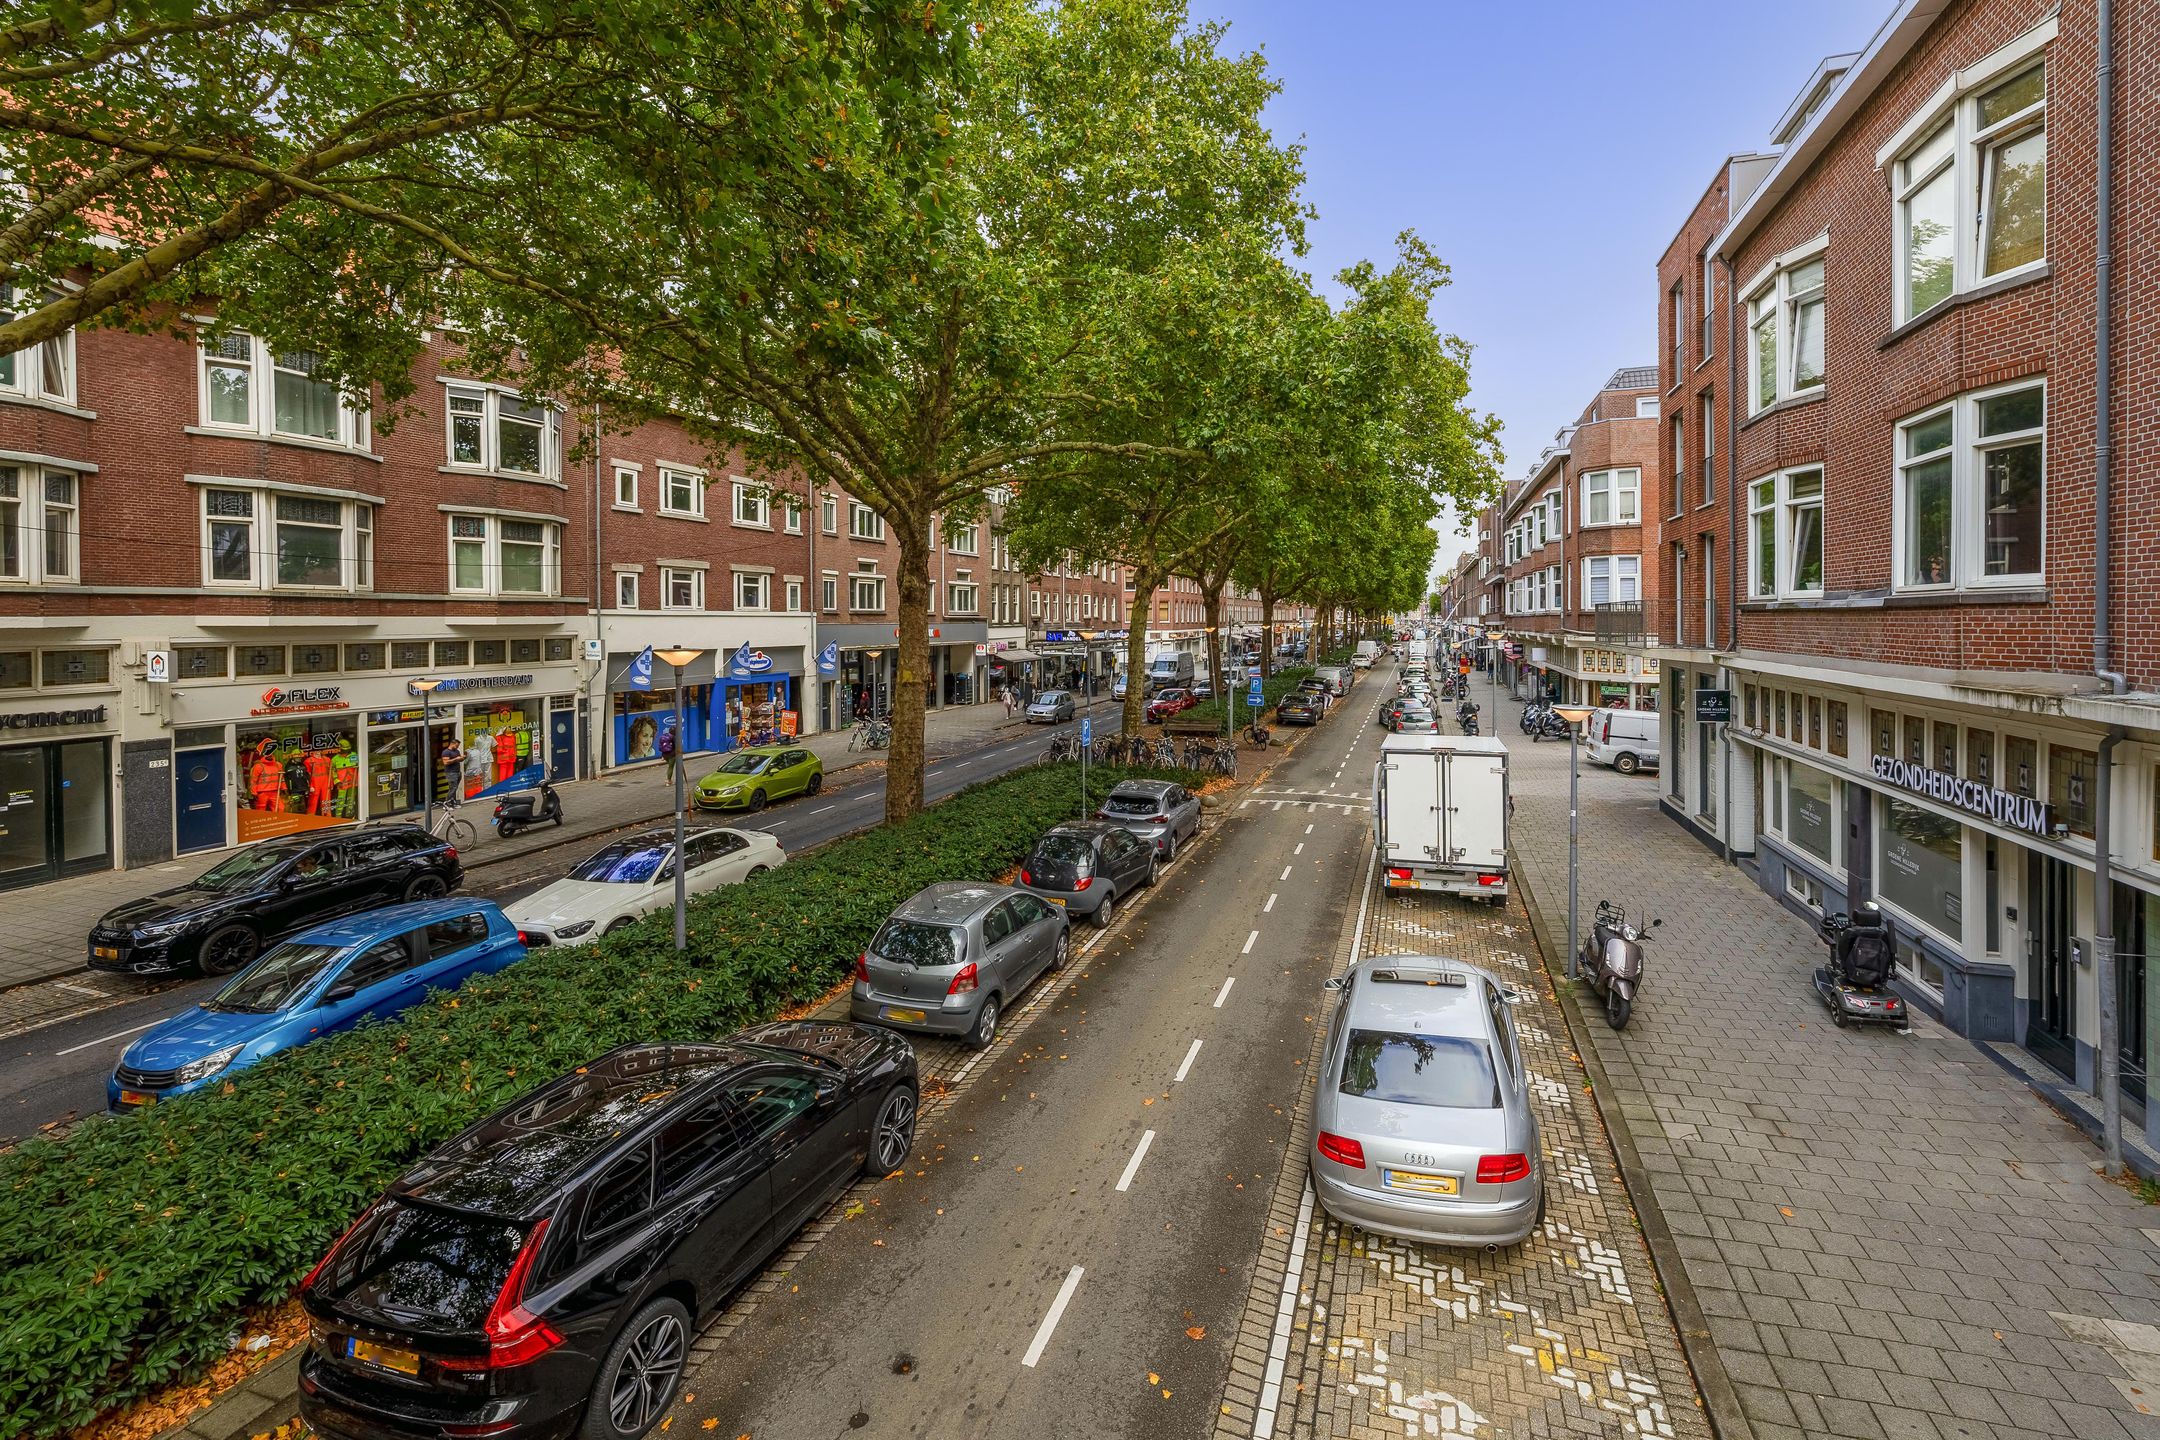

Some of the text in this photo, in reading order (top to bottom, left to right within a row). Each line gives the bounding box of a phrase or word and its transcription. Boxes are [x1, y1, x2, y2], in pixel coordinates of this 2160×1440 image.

[434, 674, 533, 692] BMROTTERDAM
[1252, 679, 1260, 689] P
[289, 686, 342, 703] FLEX
[282, 732, 341, 753] FLEX
[1872, 754, 2047, 836] GEZONDHEIDSCENTRUM
[504, 1226, 521, 1251] Ravza
